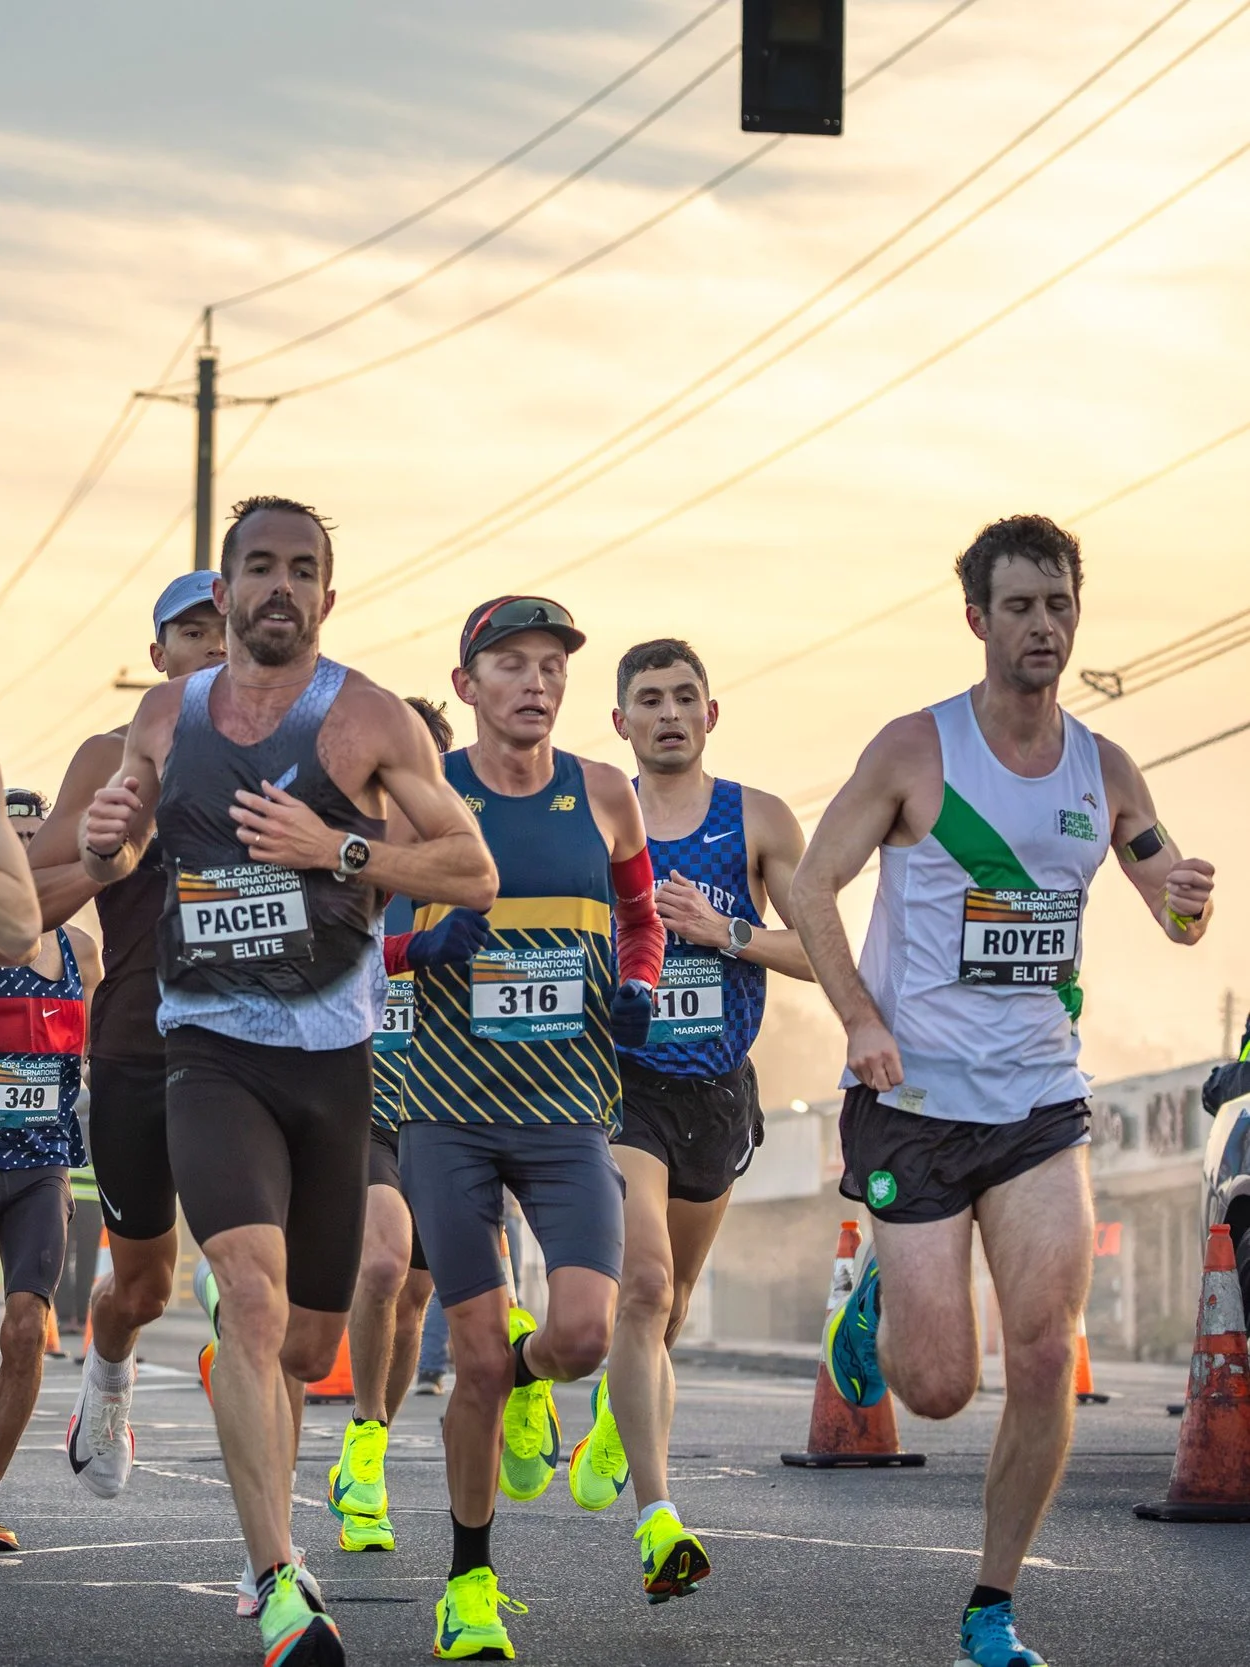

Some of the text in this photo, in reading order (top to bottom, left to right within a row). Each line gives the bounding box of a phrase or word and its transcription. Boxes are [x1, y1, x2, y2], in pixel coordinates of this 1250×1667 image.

[1059, 809, 1090, 822] GREEN
[1060, 818, 1093, 832] RACING
[1060, 827, 1098, 842] PROJECT
[202, 869, 226, 880] 2024
[233, 864, 287, 877] CALIFOR
[216, 871, 299, 889] INTERNATIONAL
[239, 880, 301, 896] MARATHON
[995, 891, 1022, 900] 2024
[1010, 900, 1078, 911] INTERNATIONAL
[196, 901, 288, 935] PACER
[1032, 909, 1078, 921] MARATHON
[232, 938, 285, 960] ELITE
[983, 929, 1065, 956] ROYER
[490, 952, 516, 961] 2024
[524, 949, 583, 960] CALIFORNIA
[505, 959, 583, 970] INTERNATIONAL
[665, 957, 721, 968] CALIFORNIA
[527, 968, 583, 979] MARATHON
[662, 966, 721, 977] ERNATIONAL
[1012, 966, 1058, 981] ELITE
[668, 975, 722, 985] MARATHON
[498, 984, 558, 1015] 316
[382, 1008, 409, 1031] 31
[531, 1021, 583, 1033] MARATHON
[673, 1024, 723, 1035] MARATHON
[1, 1061, 20, 1069] 2024
[25, 1061, 61, 1069] CALIFORNIA
[5, 1087, 45, 1109] 349
